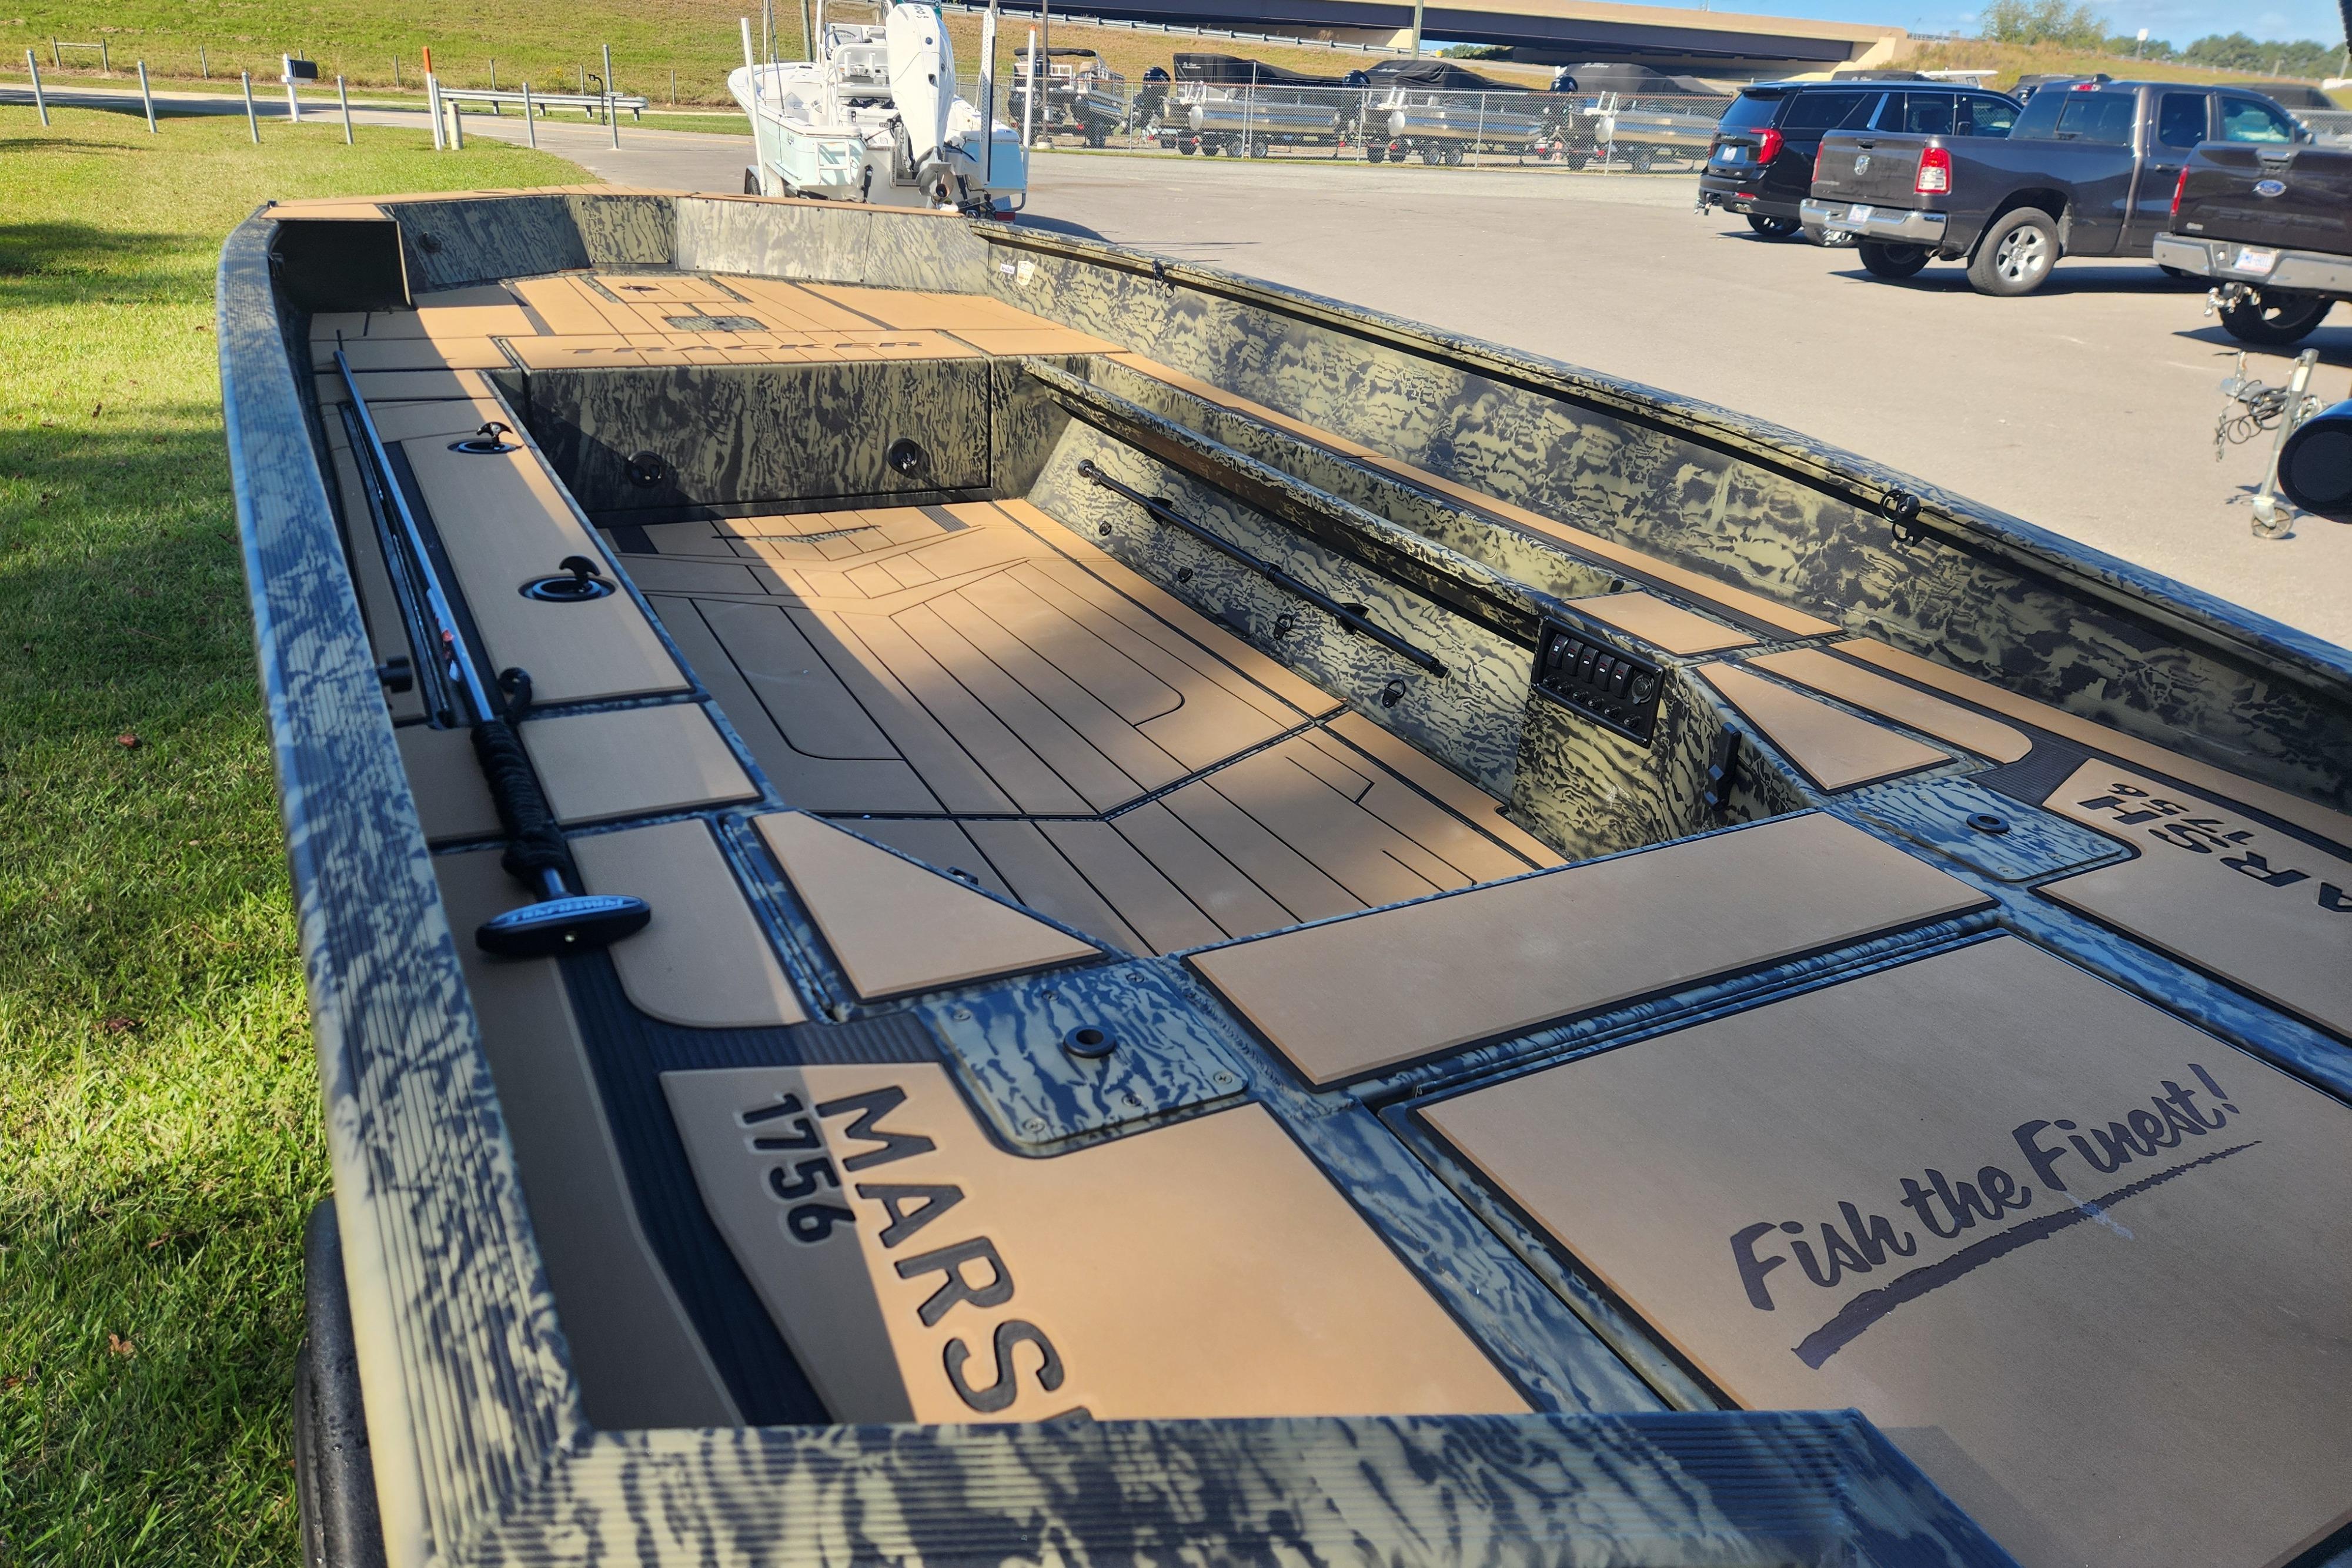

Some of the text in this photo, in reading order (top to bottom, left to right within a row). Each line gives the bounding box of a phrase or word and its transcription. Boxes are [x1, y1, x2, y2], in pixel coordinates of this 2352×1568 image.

[562, 342, 923, 354] TRACKER
[2111, 783, 2254, 845] 1756
[742, 1093, 856, 1243] 1756
[1730, 1063, 2240, 1311] Fish the Finest!
[816, 1085, 1097, 1422] MARS
